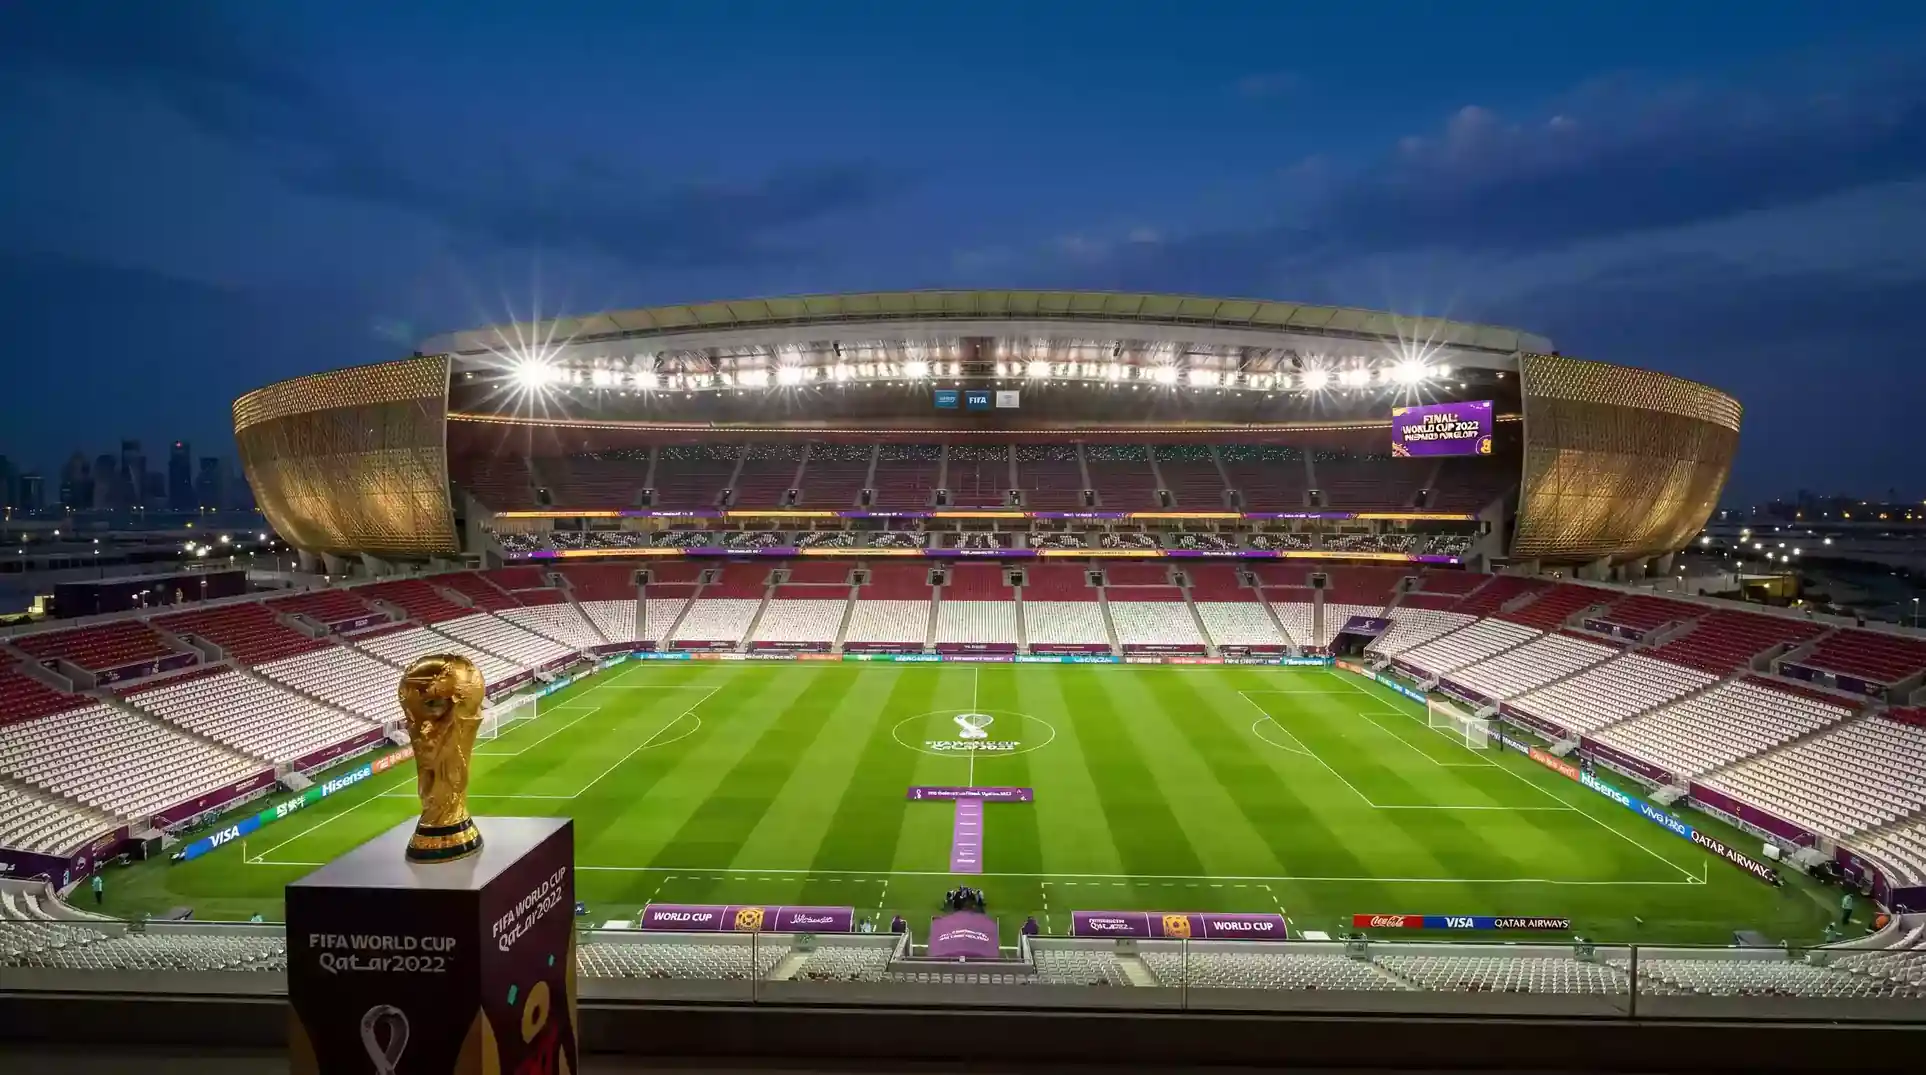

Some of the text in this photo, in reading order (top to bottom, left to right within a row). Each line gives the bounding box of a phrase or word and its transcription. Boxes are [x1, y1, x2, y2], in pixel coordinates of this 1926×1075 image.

[969, 396, 987, 404] FIFA
[1402, 424, 1434, 434] WORLD
[1436, 423, 1455, 432] CUP
[322, 767, 371, 796] Hisense
[1581, 773, 1630, 806] Hisense
[208, 826, 240, 847] VISA
[1691, 828, 1773, 881] QATAR AIRWAY
[492, 866, 566, 938] FIFA WORLD CUP
[499, 886, 562, 952] Qatar2022
[653, 912, 713, 922] WORLD CUP
[1213, 921, 1274, 931] WORLD CUP
[1444, 917, 1474, 928] VISA
[1494, 919, 1569, 928] QATAR AIRWAYS
[309, 933, 456, 952] FIFA WORLD CUP
